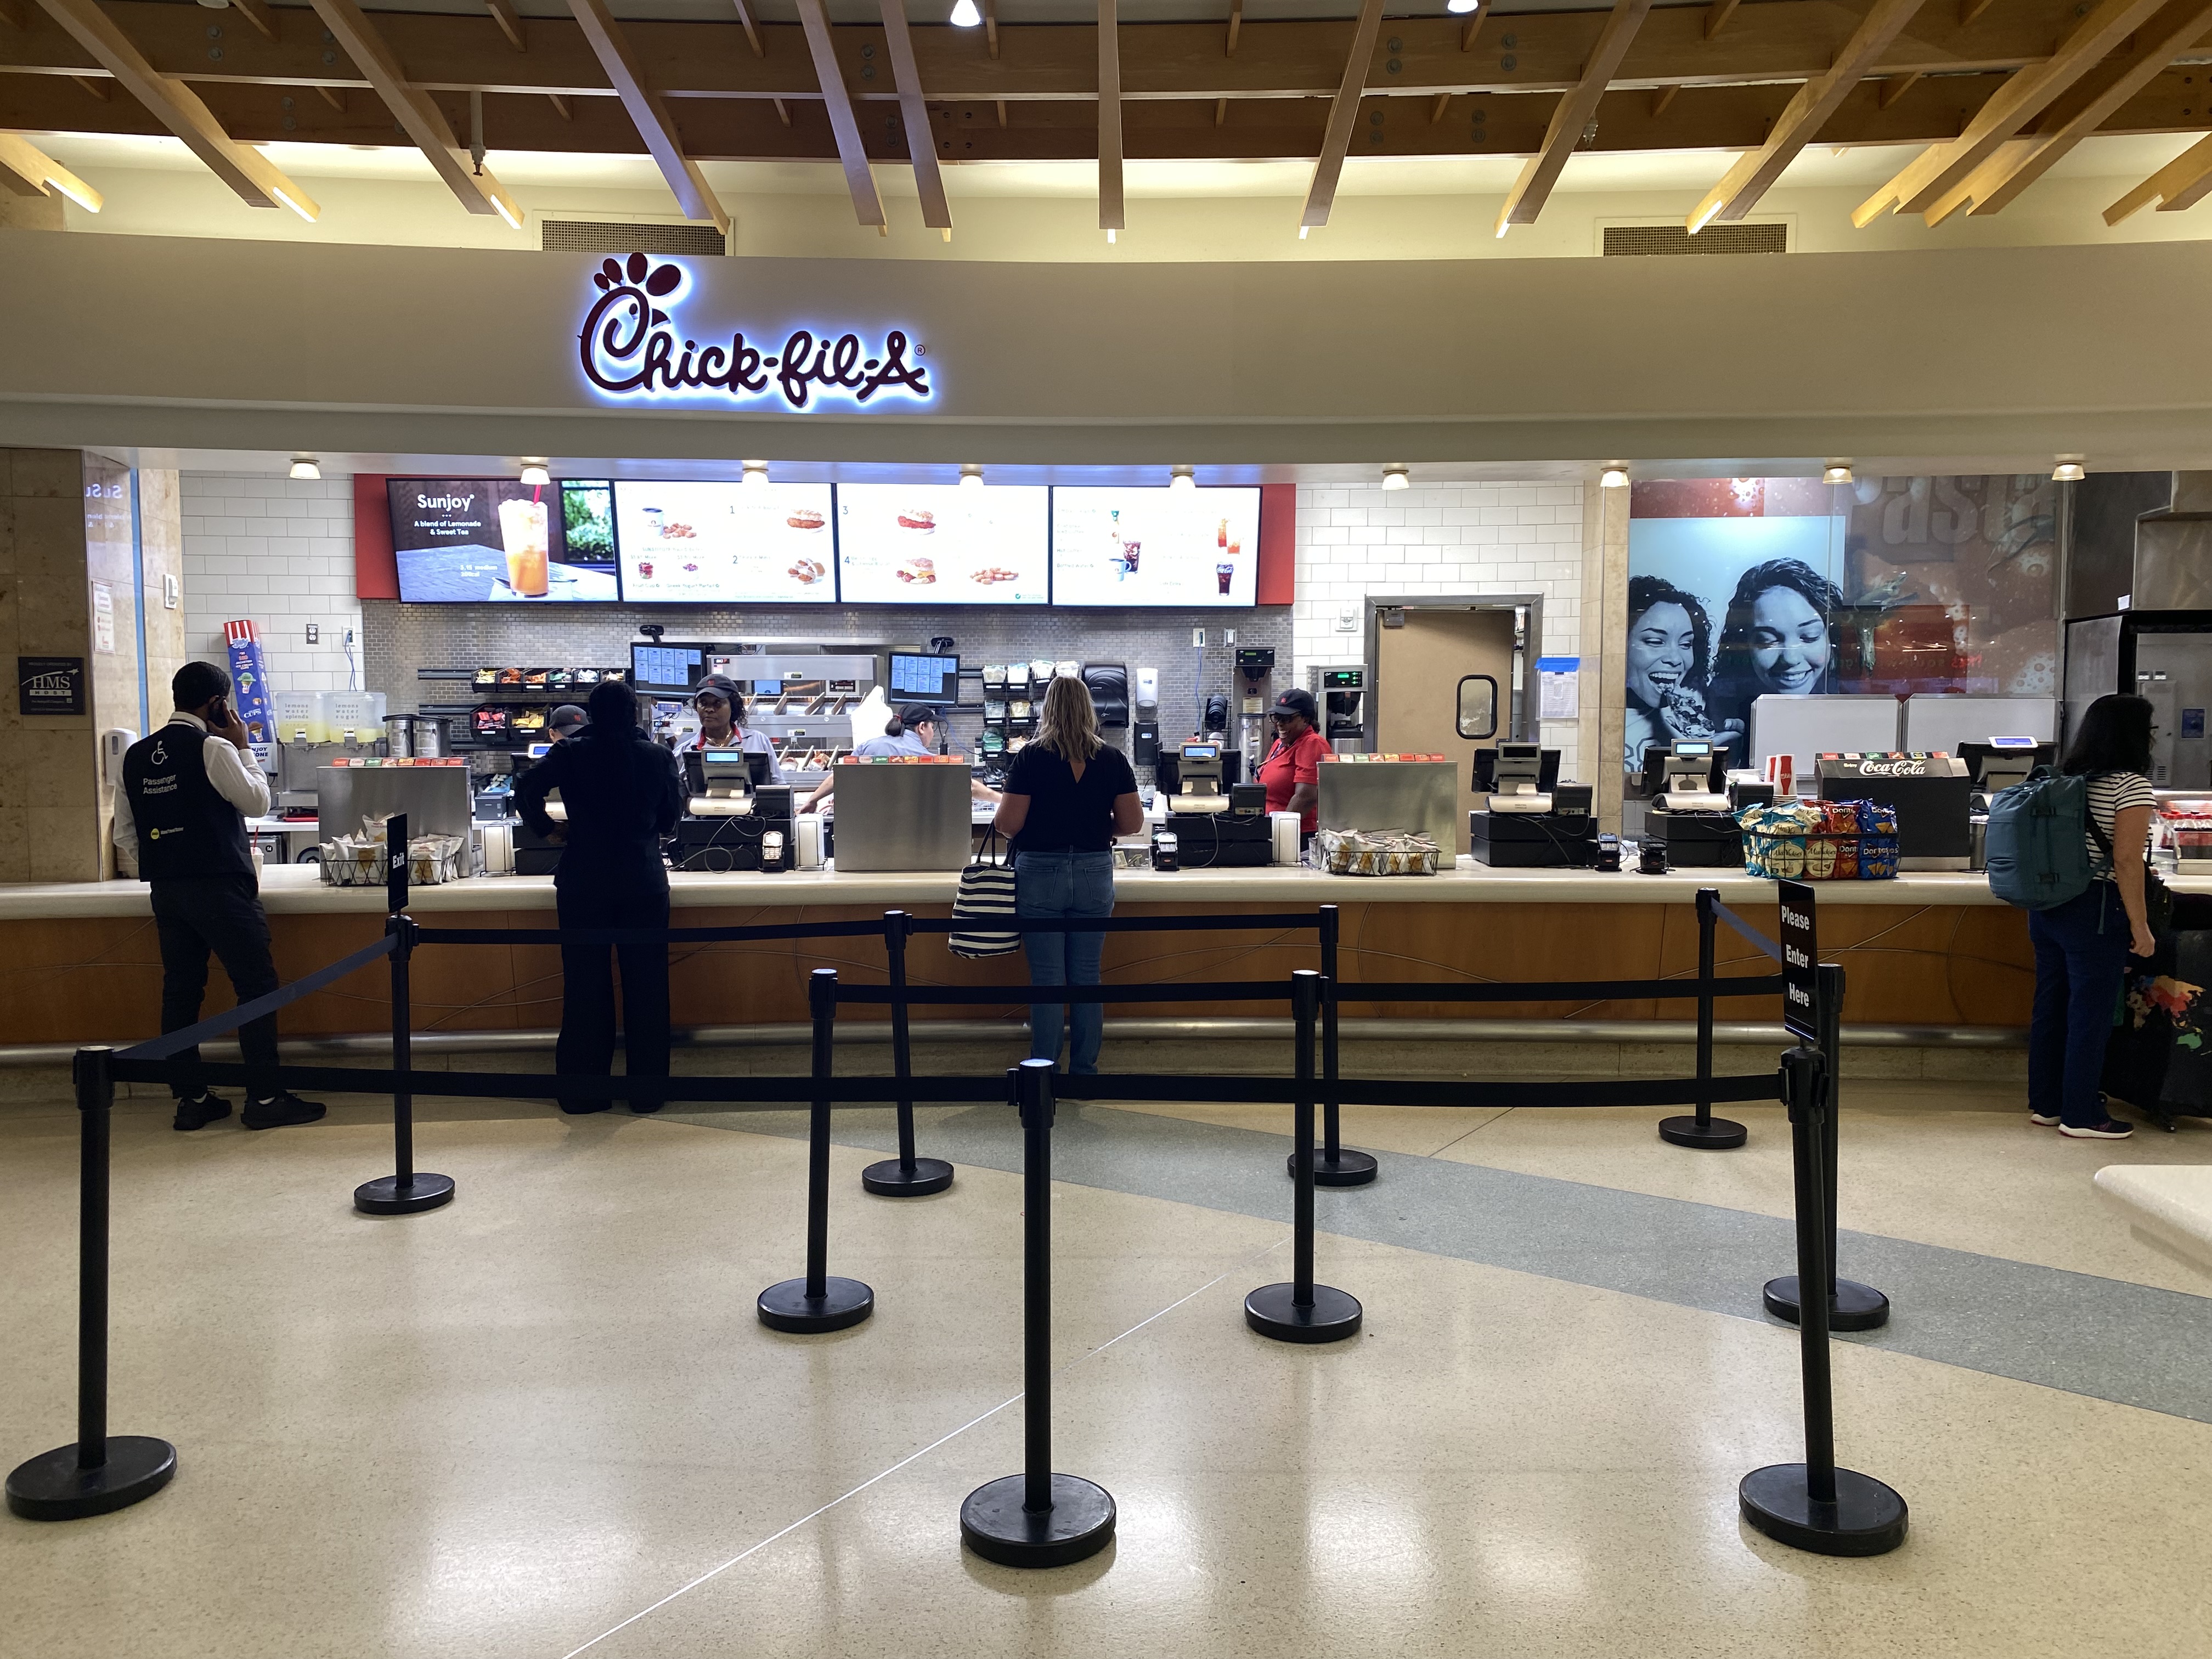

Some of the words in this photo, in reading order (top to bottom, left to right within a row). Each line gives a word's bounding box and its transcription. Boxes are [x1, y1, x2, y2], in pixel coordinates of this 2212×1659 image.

[578, 286, 929, 407] Chick-fil-A
[417, 493, 472, 512] Sunjoy
[730, 505, 735, 514] 1
[843, 505, 849, 515] 3
[732, 555, 738, 564] 2
[844, 556, 850, 564] 4
[32, 676, 70, 689] HMS
[1859, 760, 1926, 776] Coca-Cola
[143, 774, 176, 785] Passenger
[143, 783, 177, 794] Assistance
[393, 853, 404, 869] Exit
[1781, 905, 1810, 930] Please
[1786, 944, 1809, 969] Enter
[1788, 983, 1809, 1007] Here
